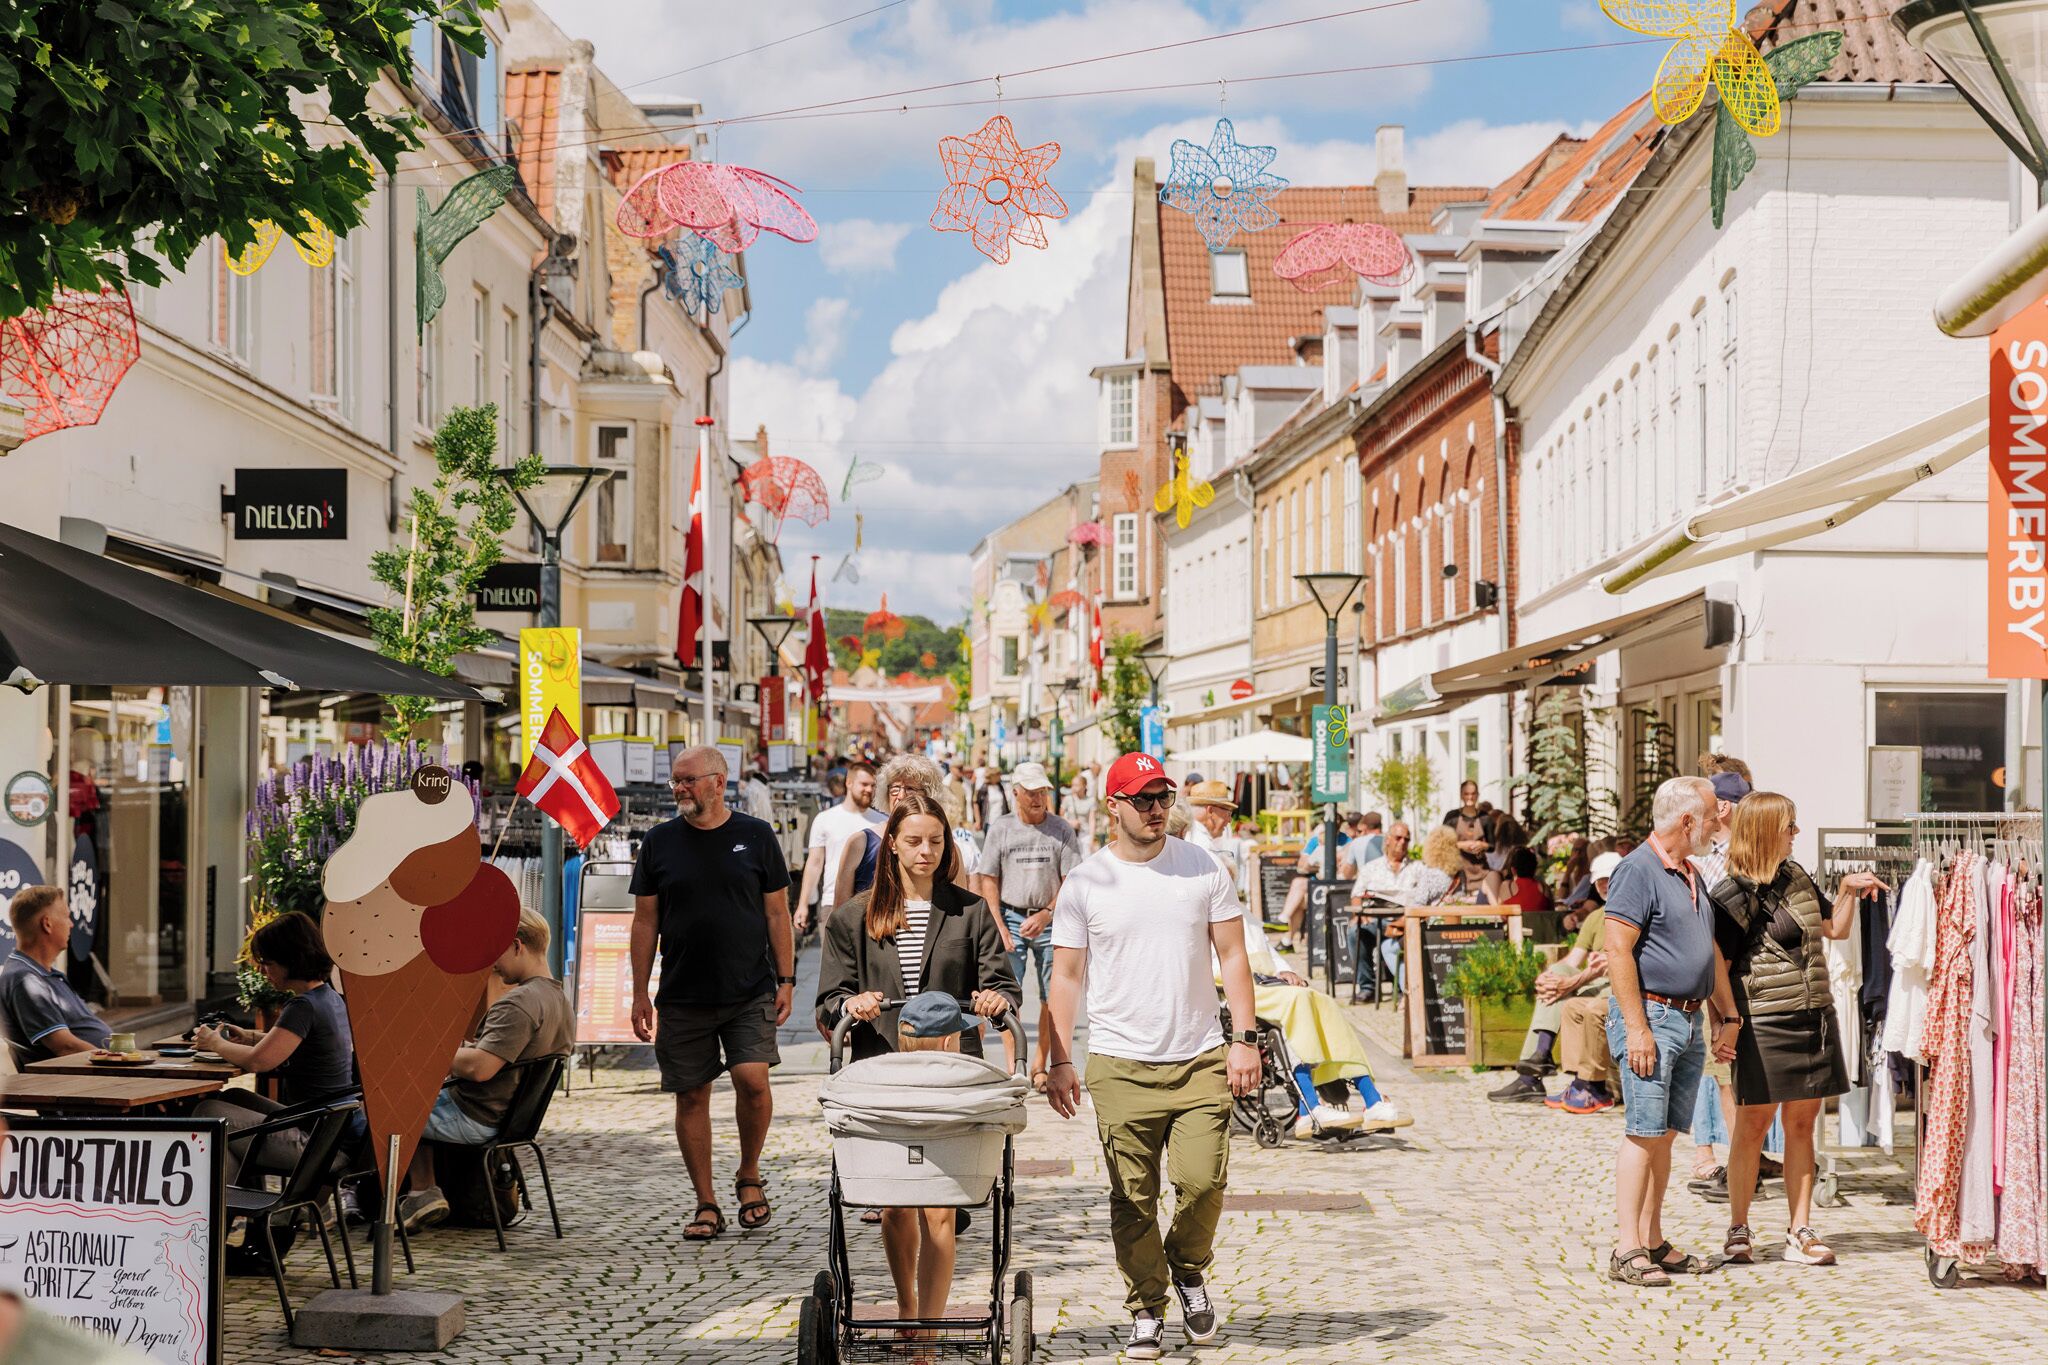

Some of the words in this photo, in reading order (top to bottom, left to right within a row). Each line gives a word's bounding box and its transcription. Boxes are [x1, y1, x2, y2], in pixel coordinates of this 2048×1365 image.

[2008, 339, 2047, 649] SOMMERBY
[418, 772, 449, 794] Kring
[1316, 719, 1328, 794] SOMMERBY
[0, 1134, 194, 1207] COCKTAILS
[25, 1230, 134, 1268] ASTRONAUT
[24, 1265, 96, 1300] SPRITZ
